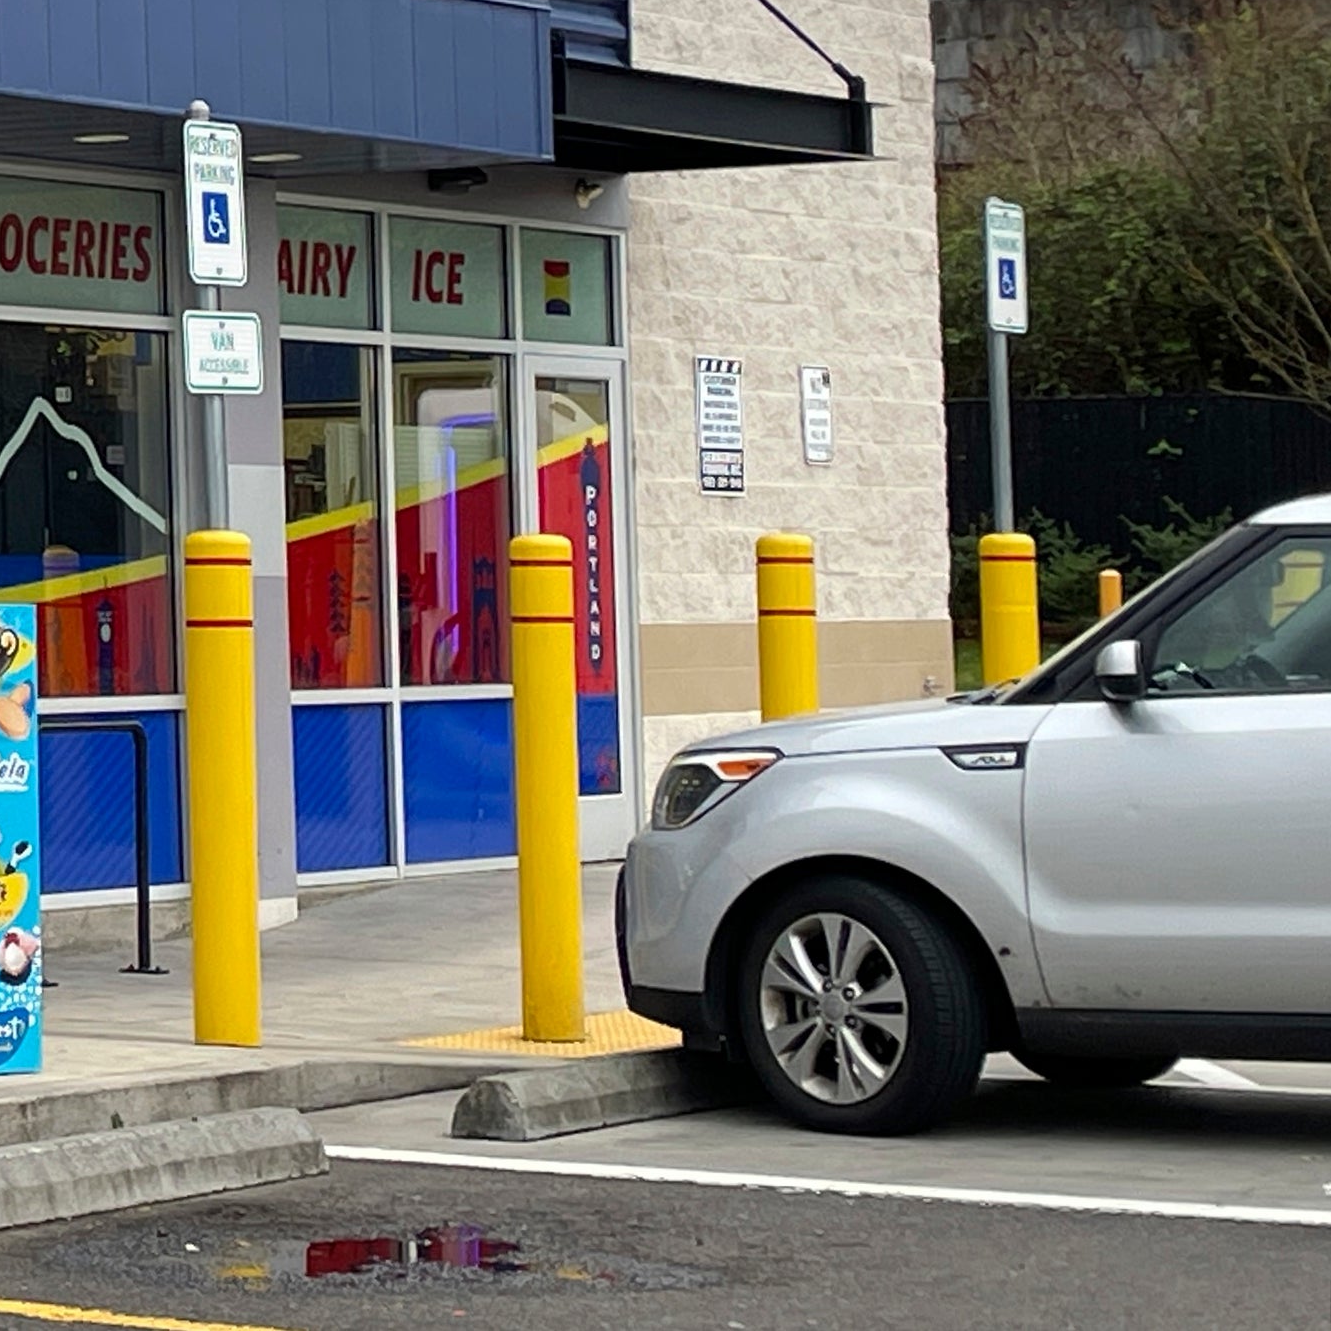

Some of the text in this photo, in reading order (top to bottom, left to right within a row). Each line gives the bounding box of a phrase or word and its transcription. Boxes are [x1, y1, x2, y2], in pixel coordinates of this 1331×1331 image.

[278, 239, 357, 299] AIRY
[412, 248, 464, 306] ICE
[211, 331, 235, 351] VAN
[585, 485, 601, 660] PORTLAND
